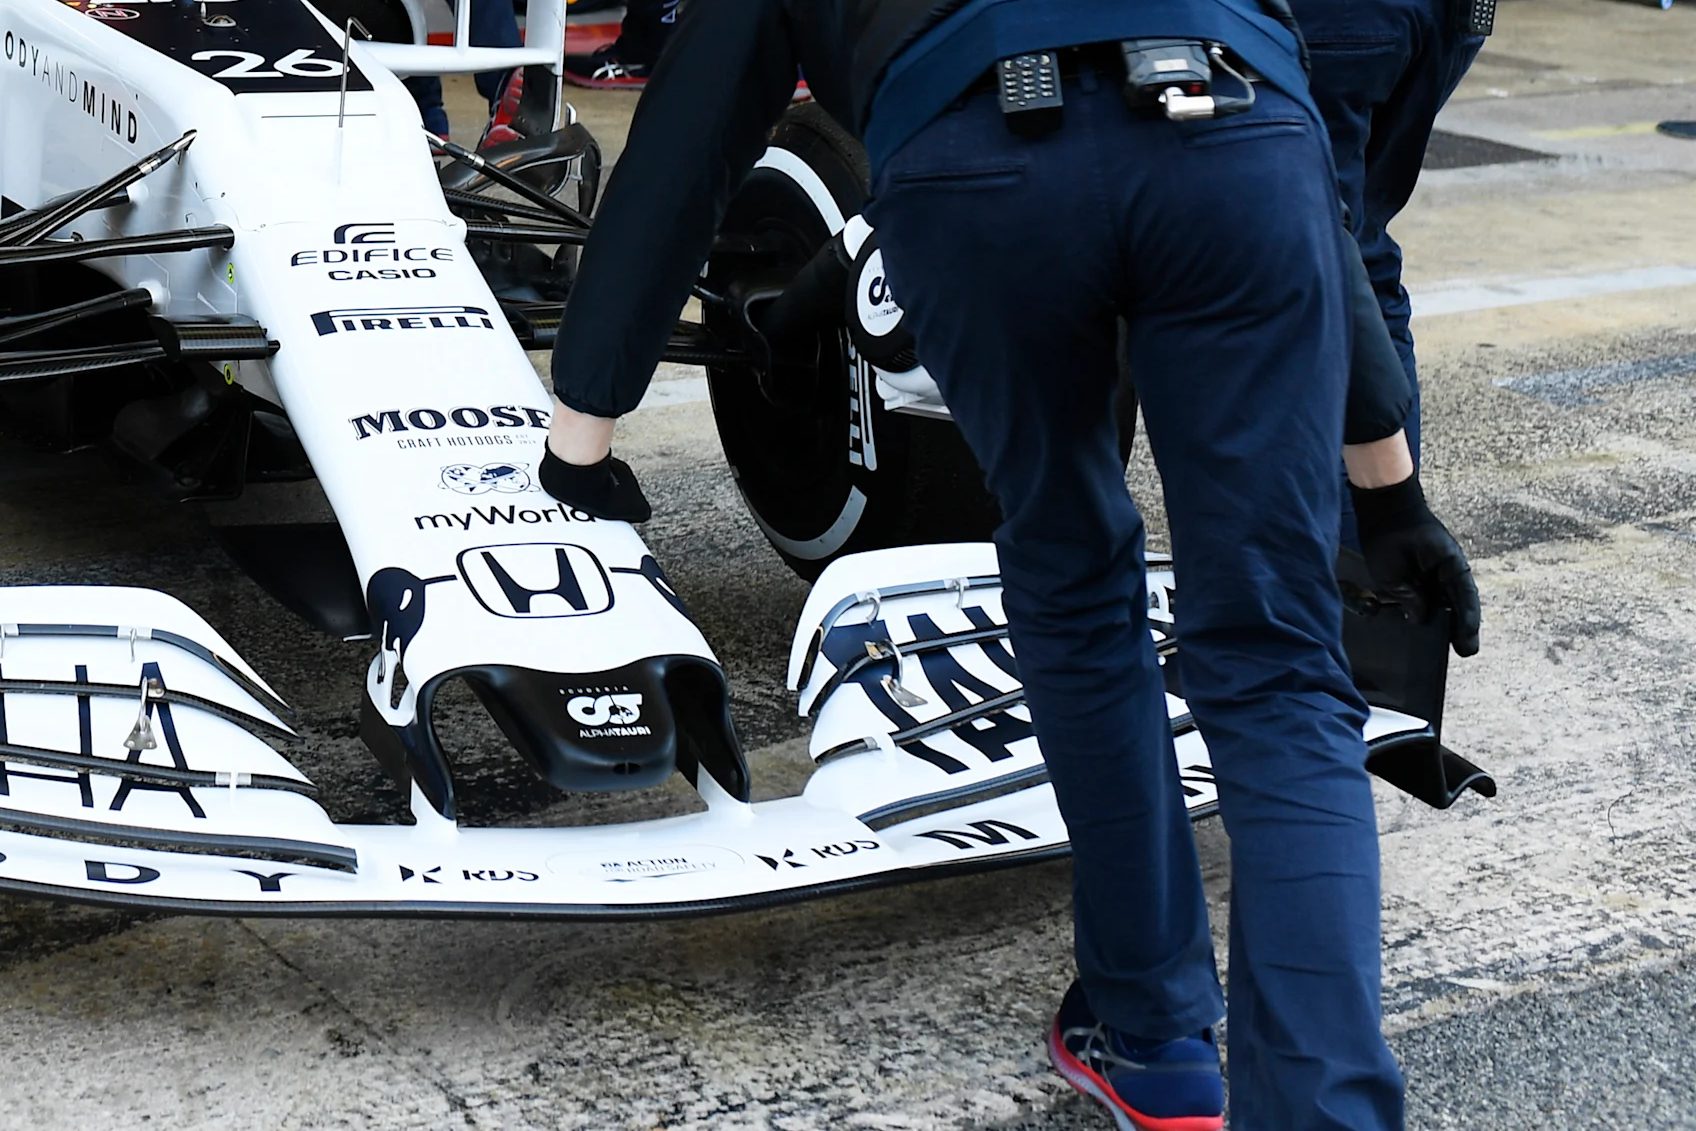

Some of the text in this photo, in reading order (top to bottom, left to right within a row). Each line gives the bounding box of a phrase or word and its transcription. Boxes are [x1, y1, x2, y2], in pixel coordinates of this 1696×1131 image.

[191, 48, 351, 78] 26
[290, 247, 454, 267] EDIFICE
[327, 268, 437, 281] CASIO
[310, 306, 494, 337] PIRELLI
[397, 434, 513, 450] CRAFT HOTDOGS
[579, 725, 652, 739] ALPHATAURI
[627, 857, 688, 867] ACTION
